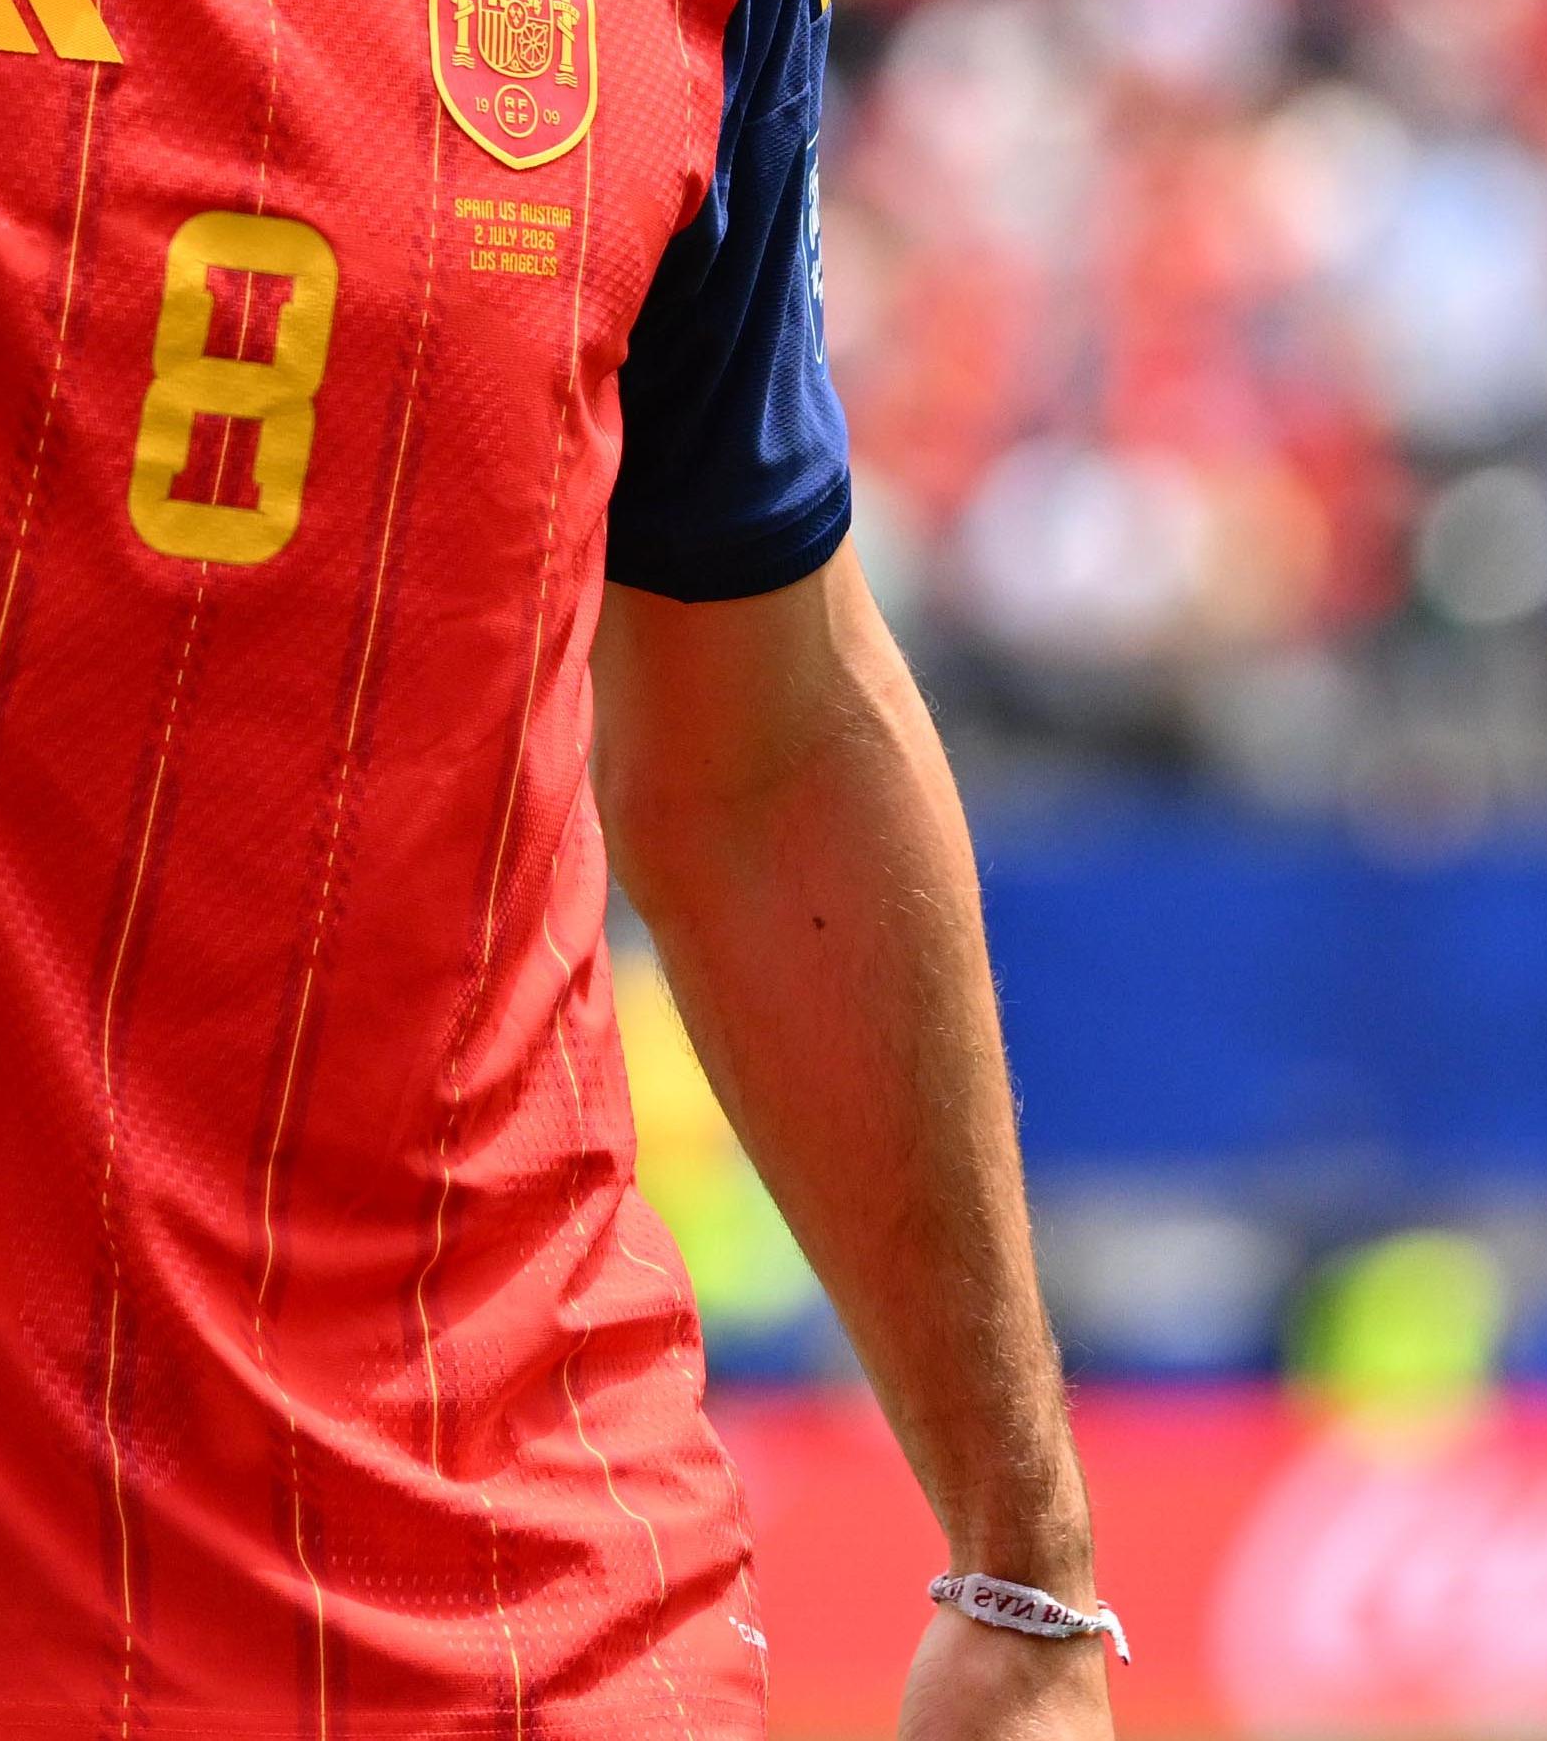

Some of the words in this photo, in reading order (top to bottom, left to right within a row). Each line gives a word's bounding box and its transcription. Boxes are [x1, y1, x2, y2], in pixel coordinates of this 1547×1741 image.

[475, 96, 490, 113] 19
[543, 109, 560, 125] 09
[454, 197, 495, 220] SPAIN
[521, 203, 572, 227] AUSTRIA
[474, 224, 484, 244] 2
[488, 226, 518, 247] JULY
[522, 228, 555, 251] 2026
[470, 250, 496, 270] LOS
[501, 252, 558, 277] ANGELES
[128, 210, 339, 567] 8
